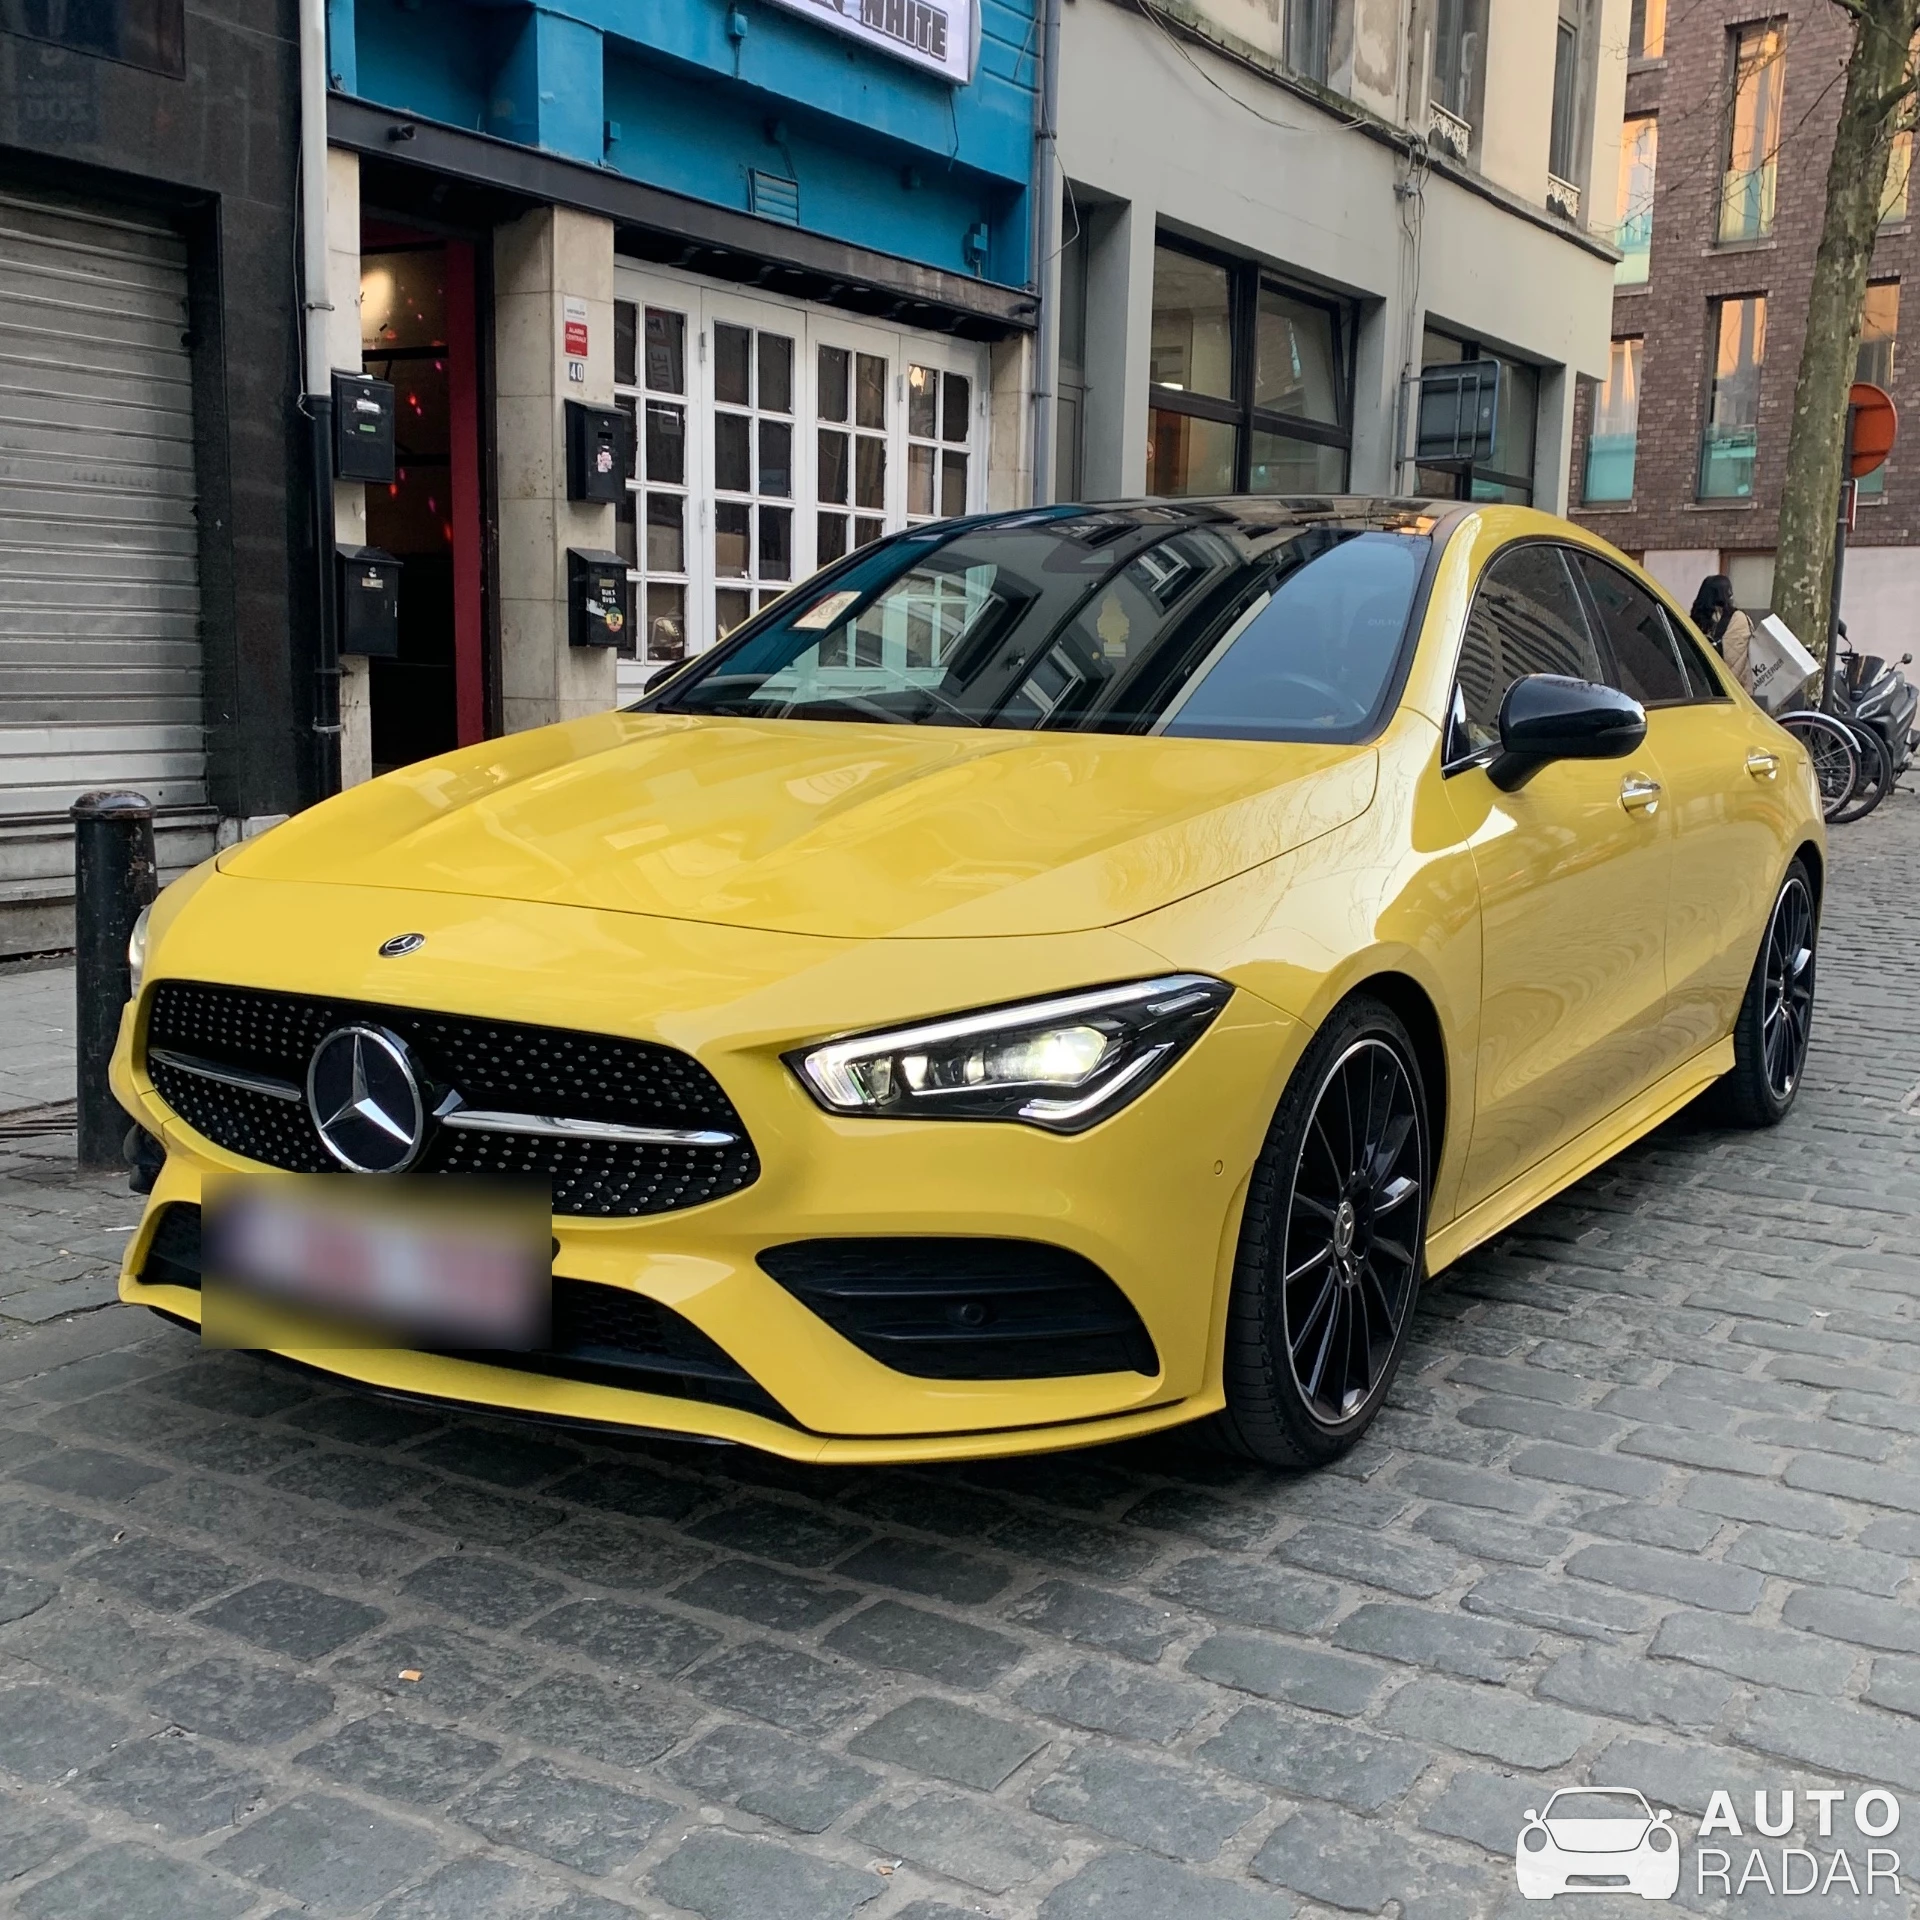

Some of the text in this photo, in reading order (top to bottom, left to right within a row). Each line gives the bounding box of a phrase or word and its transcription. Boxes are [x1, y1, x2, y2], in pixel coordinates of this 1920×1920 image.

[861, 0, 948, 62] WHITE
[570, 363, 584, 381] 40
[1752, 664, 1767, 676] K2
